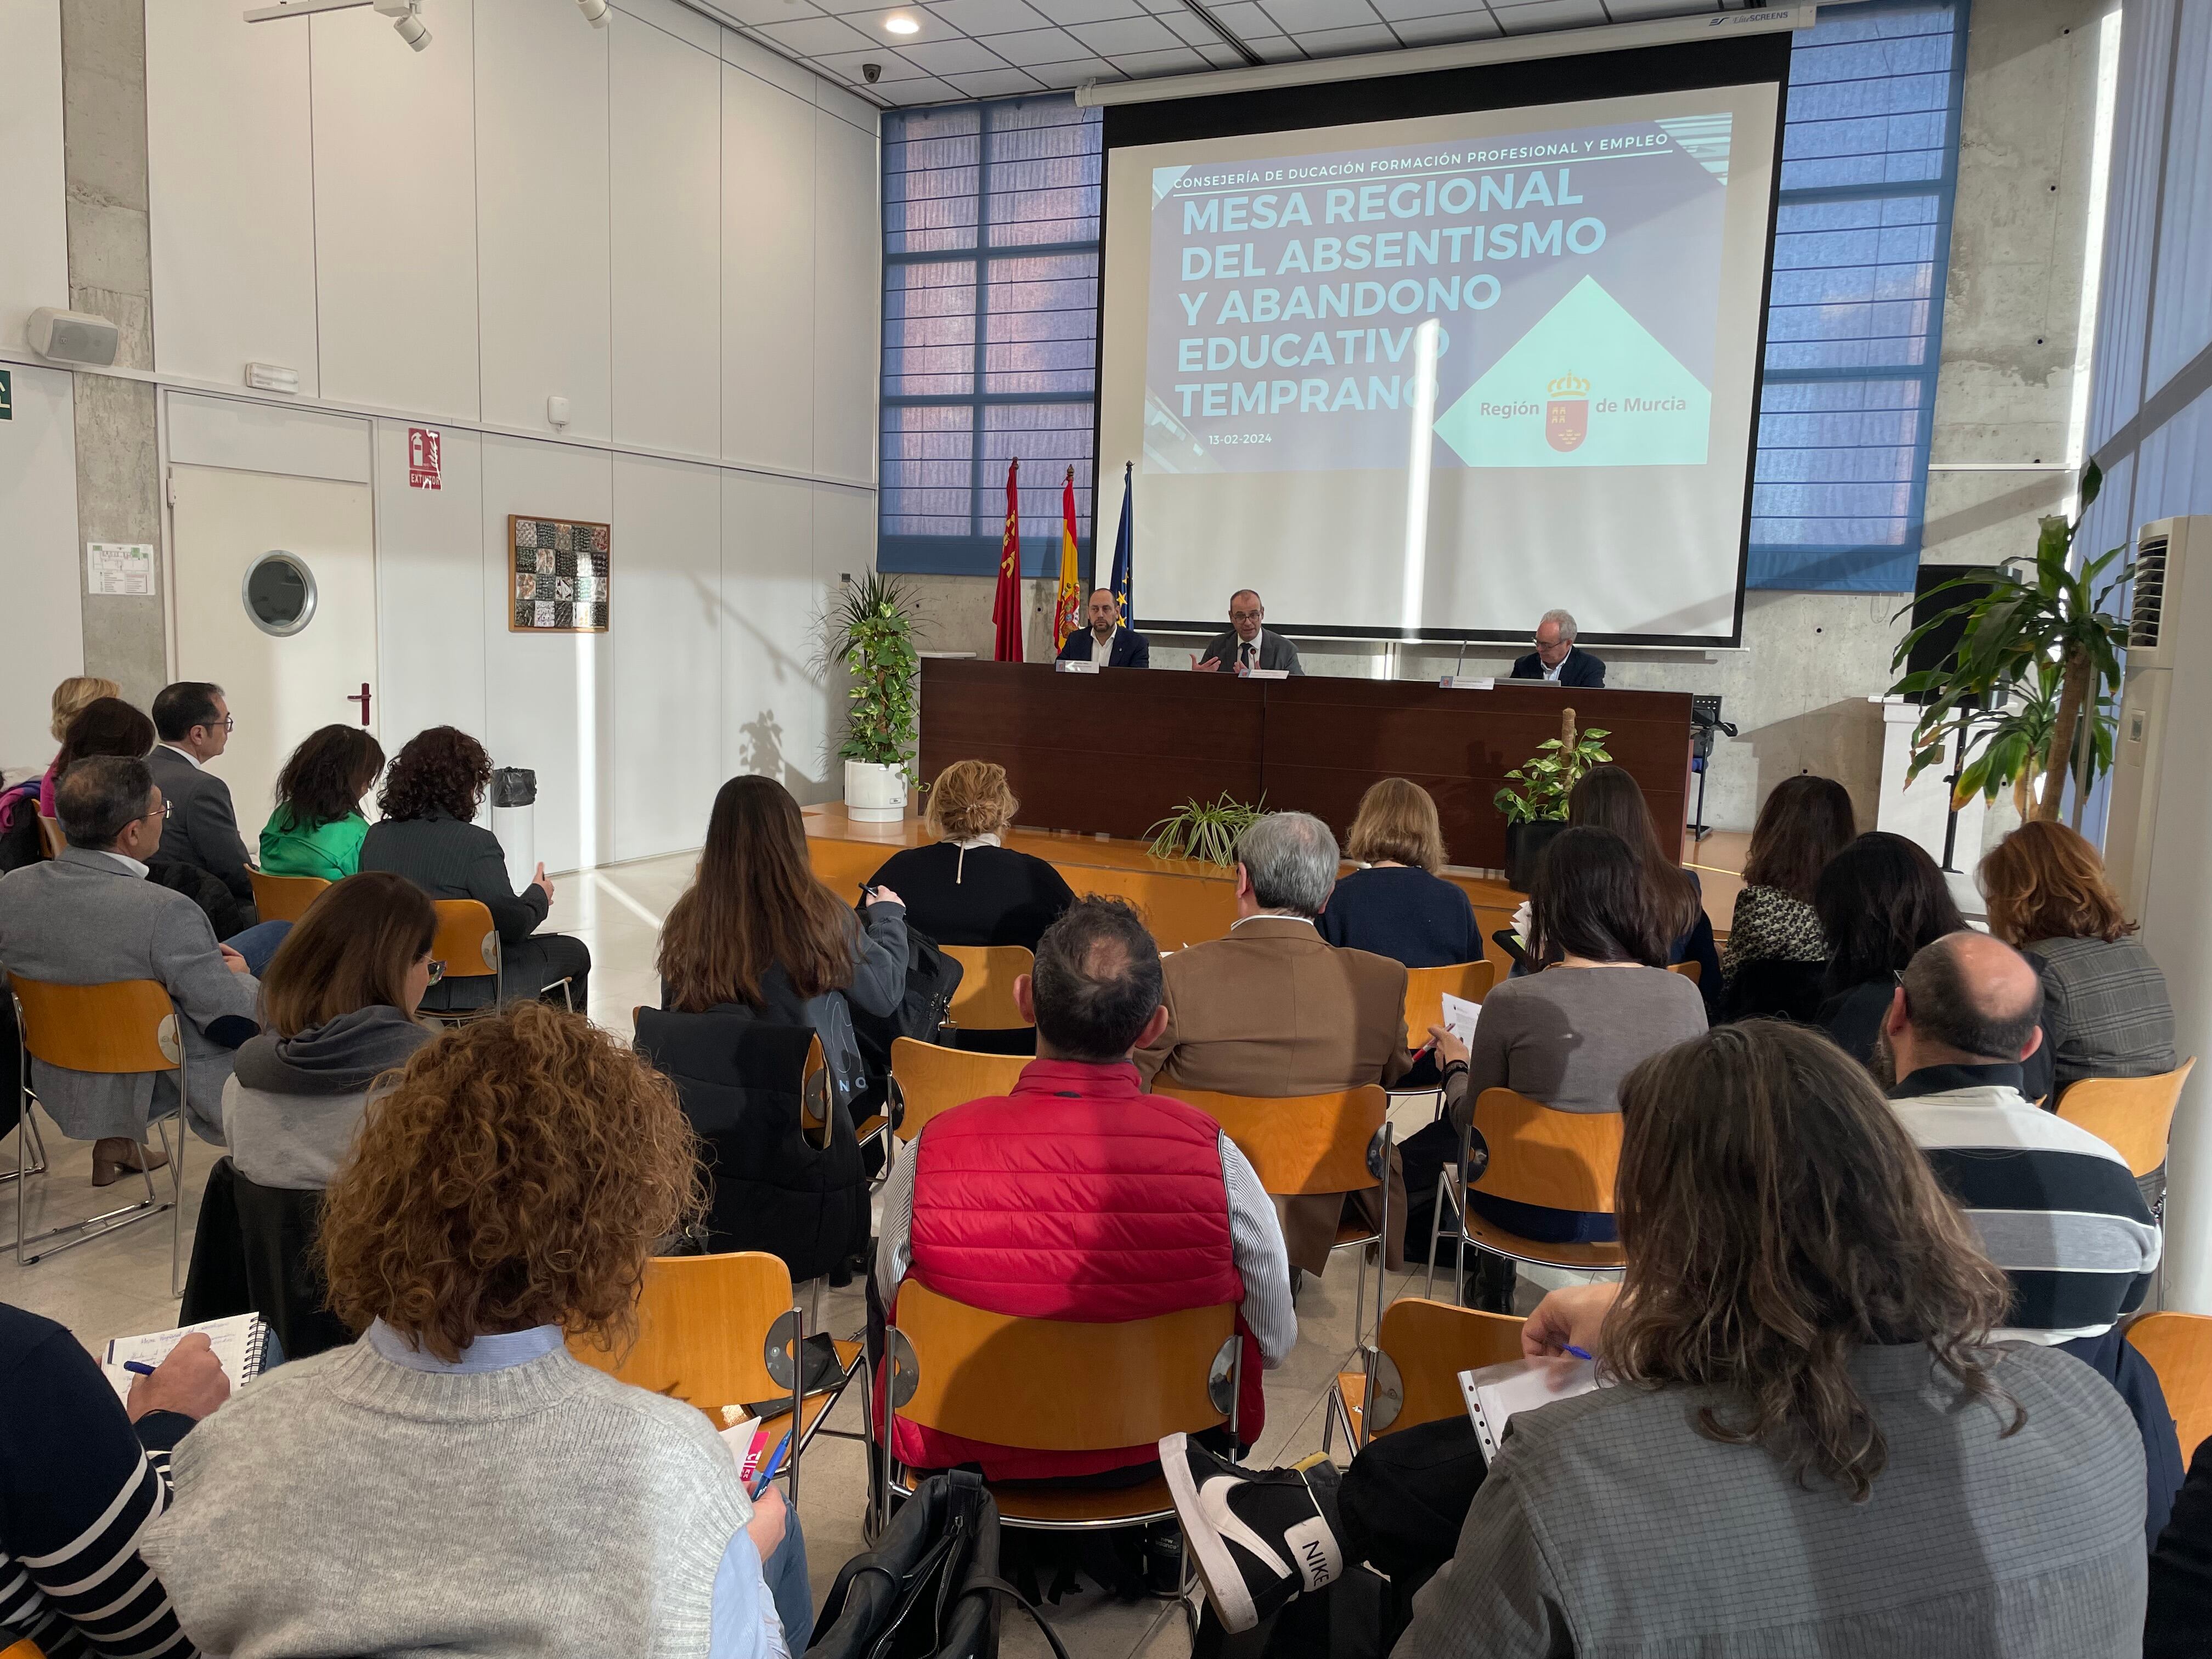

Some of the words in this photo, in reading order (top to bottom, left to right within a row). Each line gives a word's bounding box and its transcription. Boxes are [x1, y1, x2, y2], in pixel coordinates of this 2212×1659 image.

[1173, 171, 1260, 189] CONSEJERÍA
[1266, 170, 1283, 182] DE
[1289, 161, 1364, 178] DUCACIÓN
[1370, 151, 1461, 172] FORMACIÓN
[1468, 143, 1578, 163] PROFESIONAL
[1584, 140, 1594, 152] Y
[1600, 133, 1668, 150] EMPLEO
[1183, 192, 1312, 235] MESA
[1325, 168, 1583, 224] REGIONAL
[1181, 243, 1266, 281] DEL
[1276, 217, 1606, 275] ABSENTISMO
[1178, 292, 1208, 326] Y
[1216, 274, 1502, 325] ABANDONO
[1481, 401, 1539, 419] Región
[1595, 398, 1618, 413] de
[1624, 396, 1686, 411] Murcia
[1209, 433, 1272, 445] 13-02-2024
[1302, 1540, 1329, 1587] NIKE
